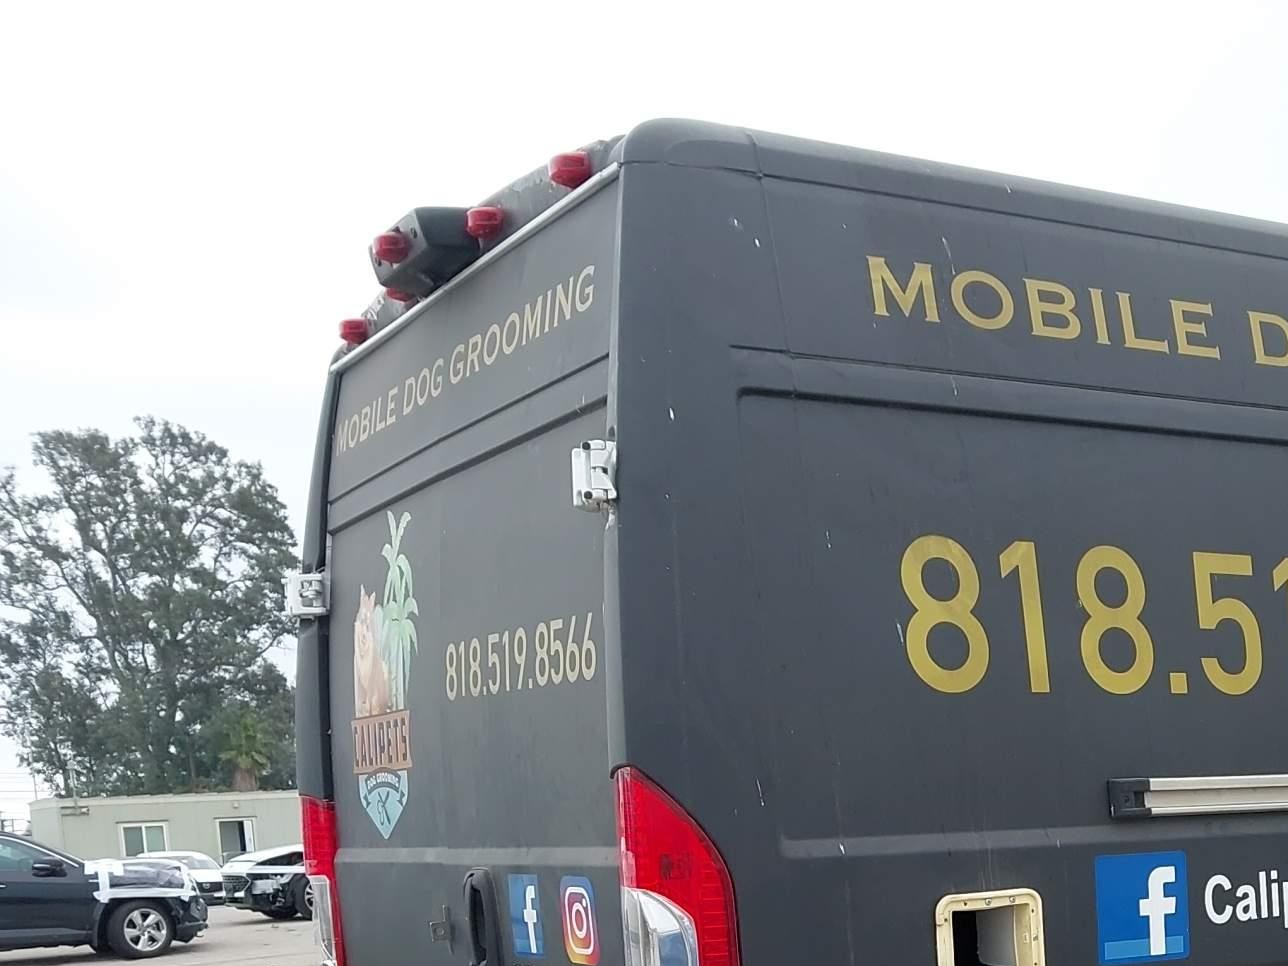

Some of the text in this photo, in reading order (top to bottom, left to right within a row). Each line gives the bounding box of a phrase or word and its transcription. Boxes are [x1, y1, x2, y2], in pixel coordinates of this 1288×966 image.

[866, 255, 1220, 361] MOBILE
[336, 265, 595, 456] MOBILE DOG GROOMING
[446, 612, 596, 701] 818.519.8566
[354, 716, 408, 768] CALIPETS
